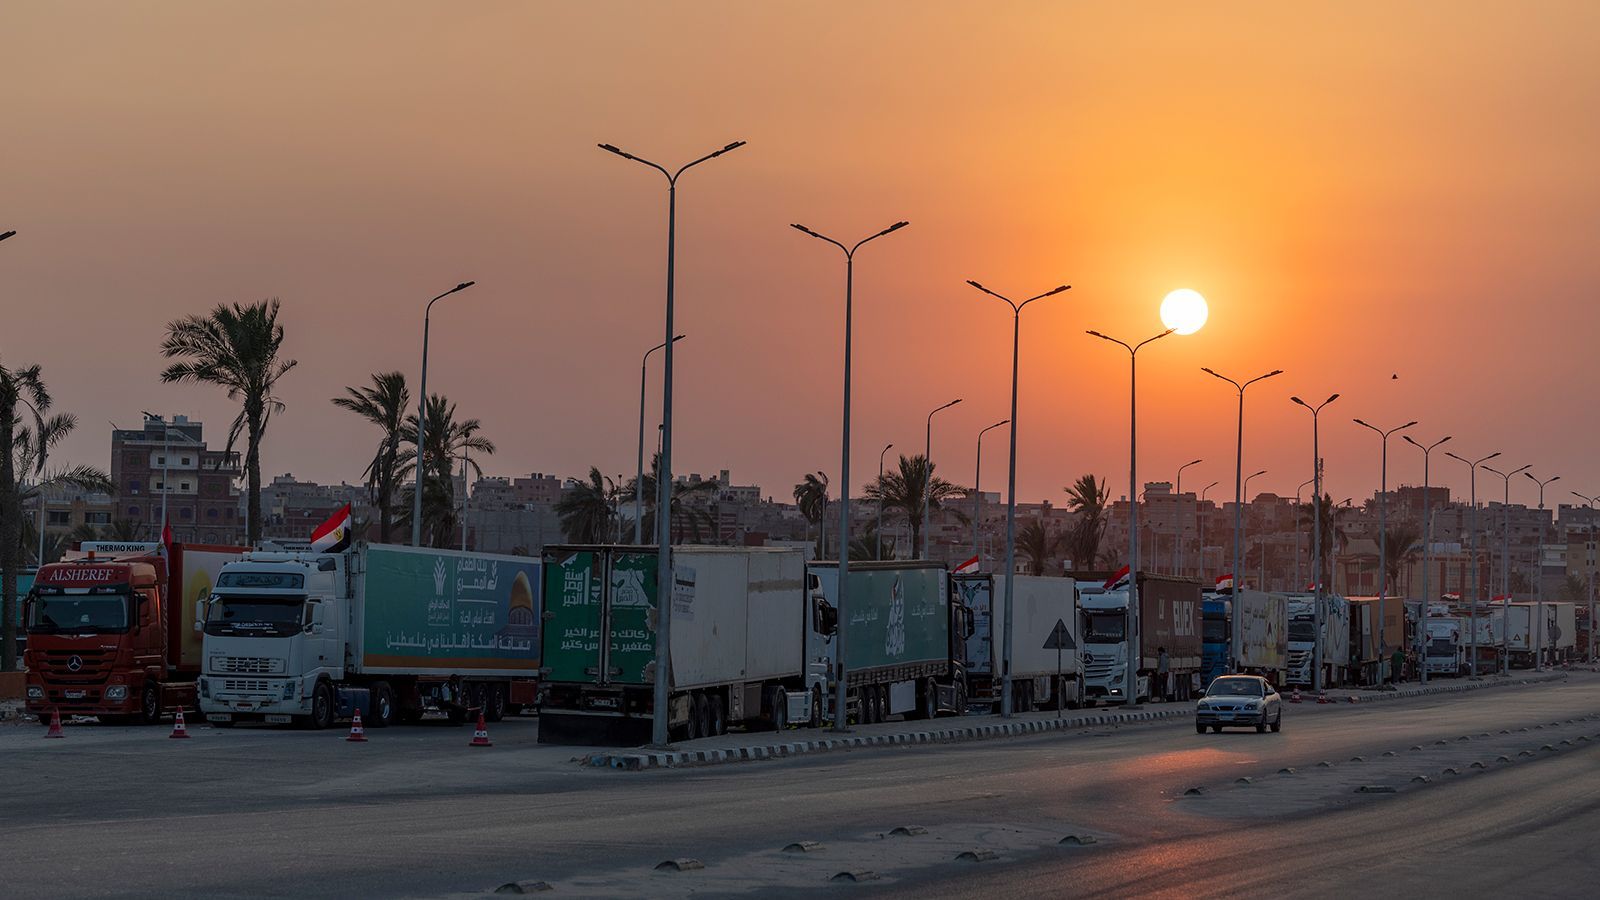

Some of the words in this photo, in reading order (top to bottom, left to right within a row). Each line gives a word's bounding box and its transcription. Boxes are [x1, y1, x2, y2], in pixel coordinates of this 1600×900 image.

[96, 544, 125, 552] THERMO
[127, 544, 145, 552] KING
[49, 568, 114, 581] ALSHEREF
[565, 568, 583, 581] سنة
[563, 580, 583, 592] مصر
[562, 592, 583, 607] الخير
[563, 627, 587, 638] الخير
[386, 630, 427, 650] فلسطين
[427, 634, 439, 654] في
[471, 633, 498, 650] السكة
[498, 635, 531, 651] مسافة
[560, 639, 583, 650] كتير
[621, 642, 652, 653] هتغير
